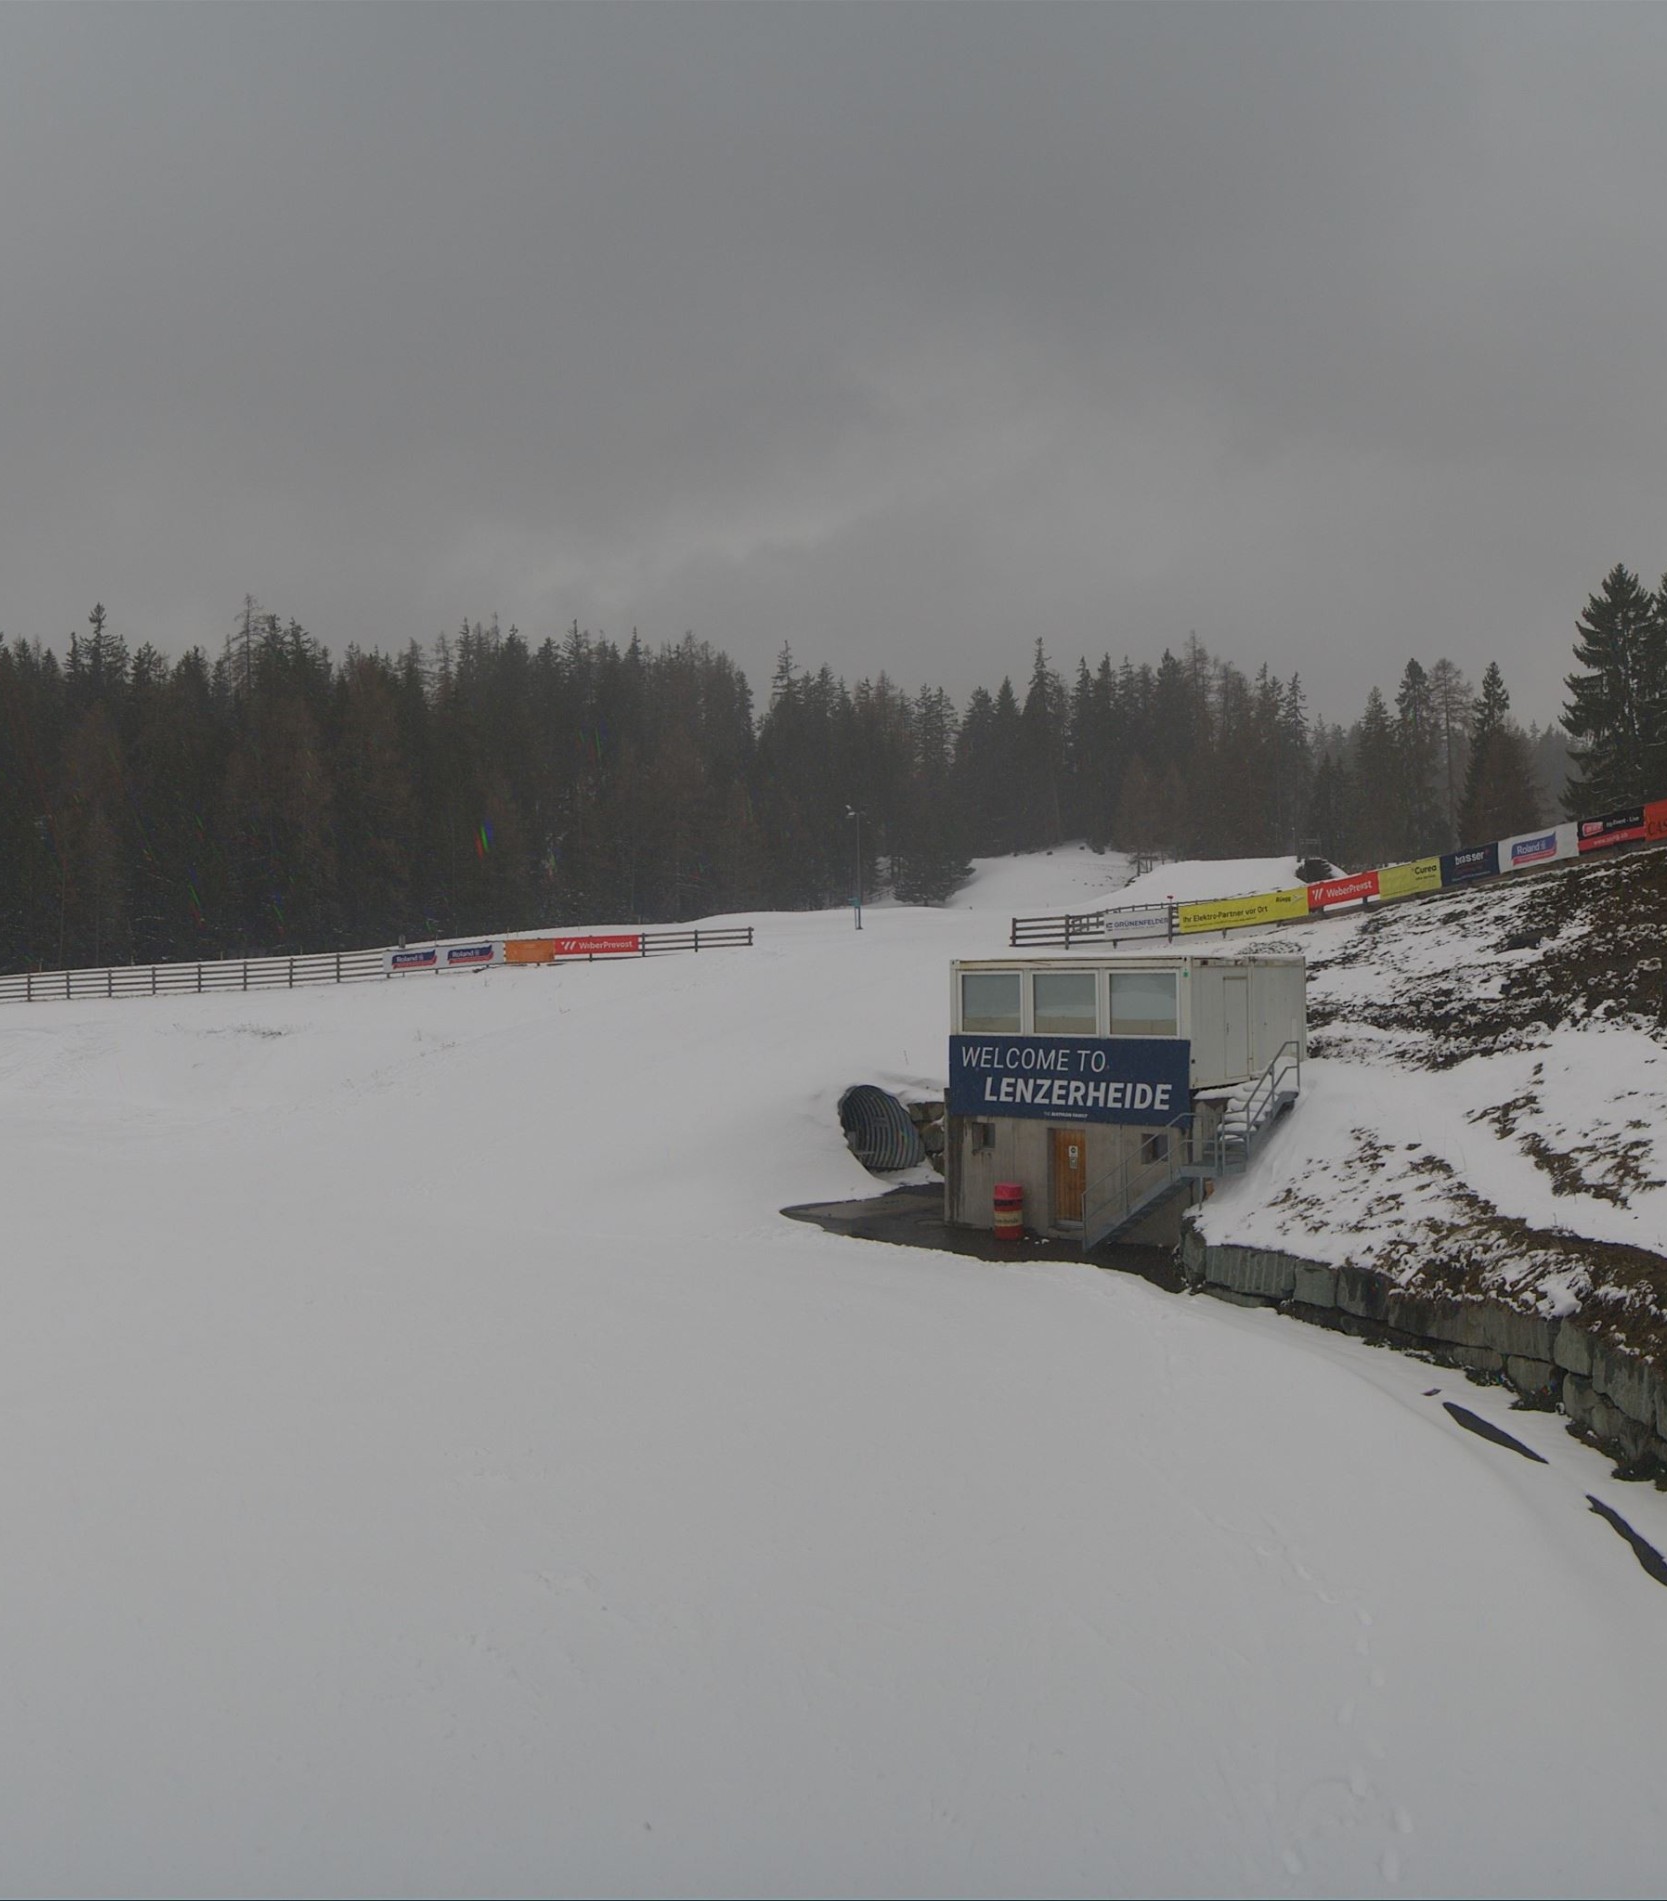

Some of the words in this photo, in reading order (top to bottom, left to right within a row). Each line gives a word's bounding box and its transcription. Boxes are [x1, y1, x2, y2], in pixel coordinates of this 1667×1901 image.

[1516, 842, 1540, 855] Roland
[1455, 851, 1485, 865] brasser
[1414, 864, 1437, 875] Curea
[1193, 910, 1244, 922] Elektro-Partner
[1258, 905, 1268, 913] Ort
[1114, 917, 1169, 928] GRÜNENFELDER
[396, 954, 417, 963] Roland
[452, 949, 473, 958] Roland
[962, 1046, 1070, 1071] WELCOME
[1077, 1050, 1106, 1073] TO
[984, 1076, 1172, 1110] LENZERHEIDE
